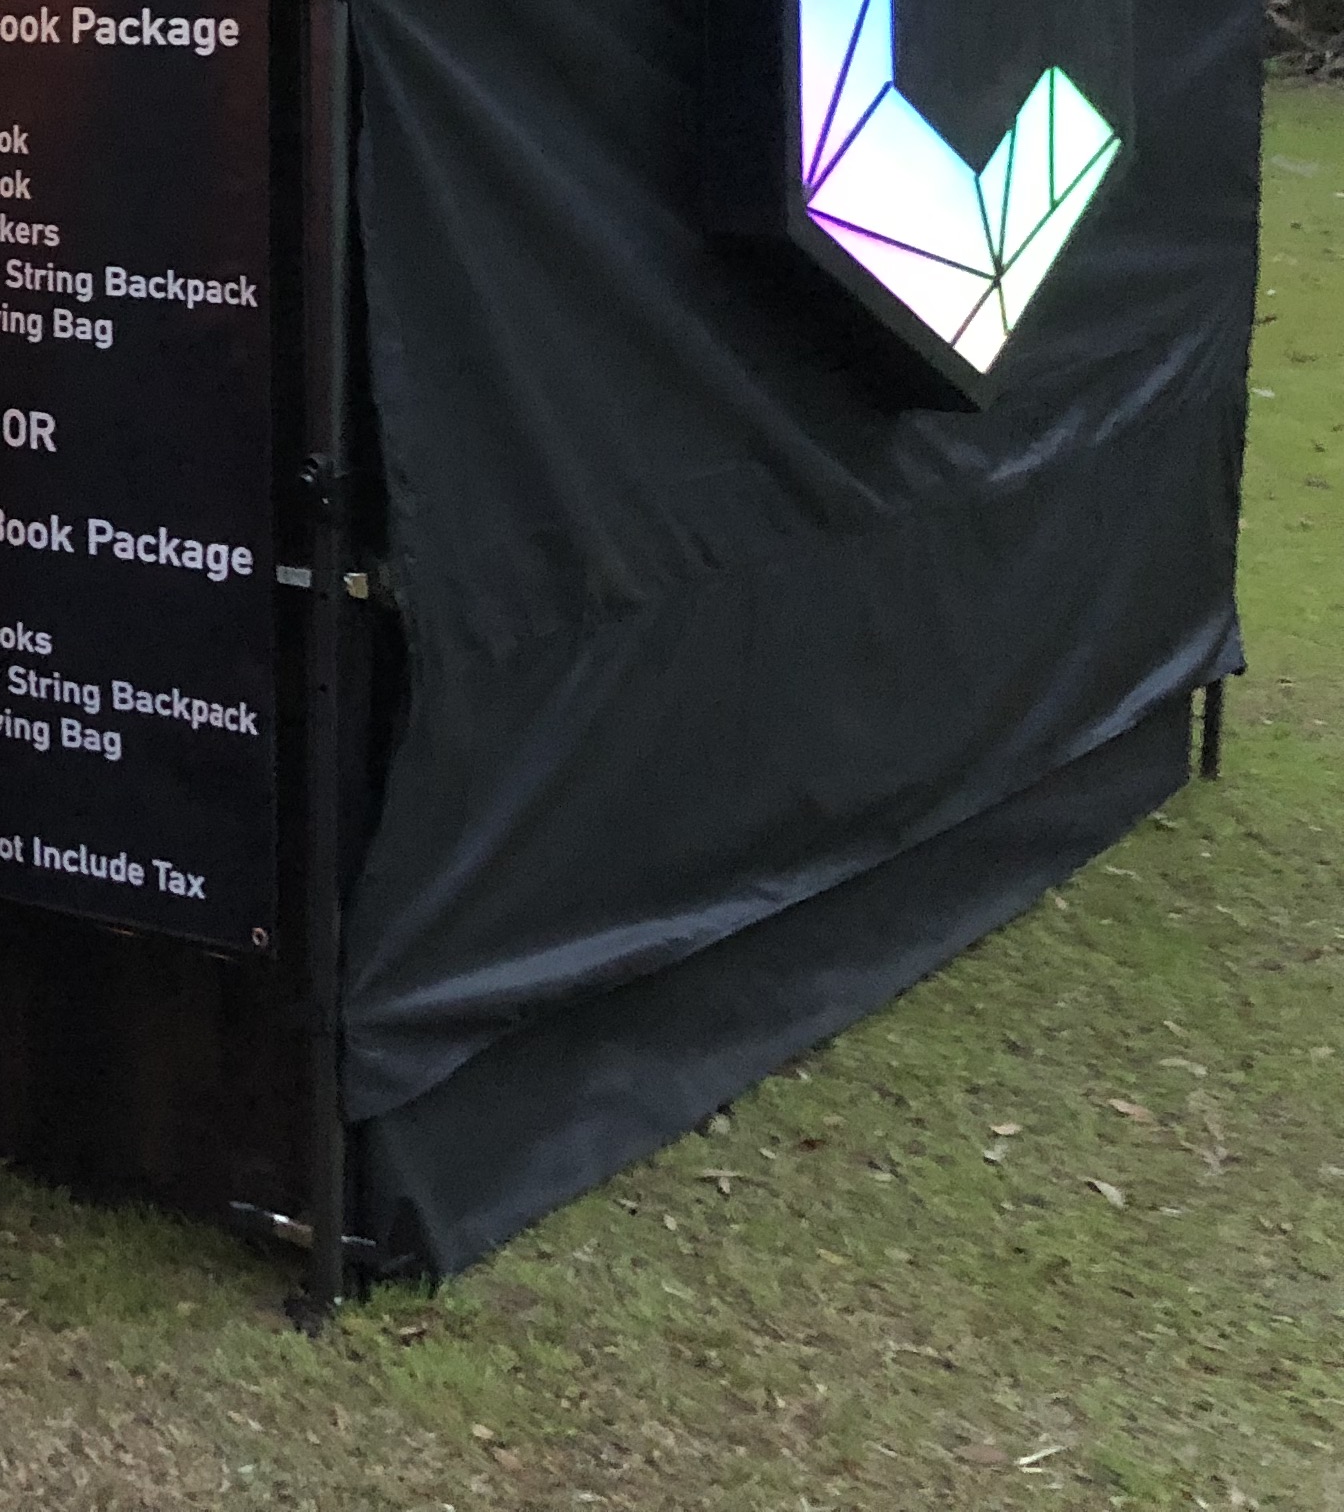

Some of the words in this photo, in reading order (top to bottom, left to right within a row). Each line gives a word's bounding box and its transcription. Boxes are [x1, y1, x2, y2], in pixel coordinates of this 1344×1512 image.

[72, 6, 240, 56] Package
[5, 258, 94, 303] String
[105, 266, 258, 309] Backpack
[53, 308, 113, 350] Bag
[2, 408, 57, 452] OR
[87, 518, 253, 582] Package
[7, 665, 101, 715] String
[111, 680, 259, 736] Backpack
[60, 717, 122, 761] Bag
[33, 836, 145, 886] Include
[152, 859, 206, 899] Tax
